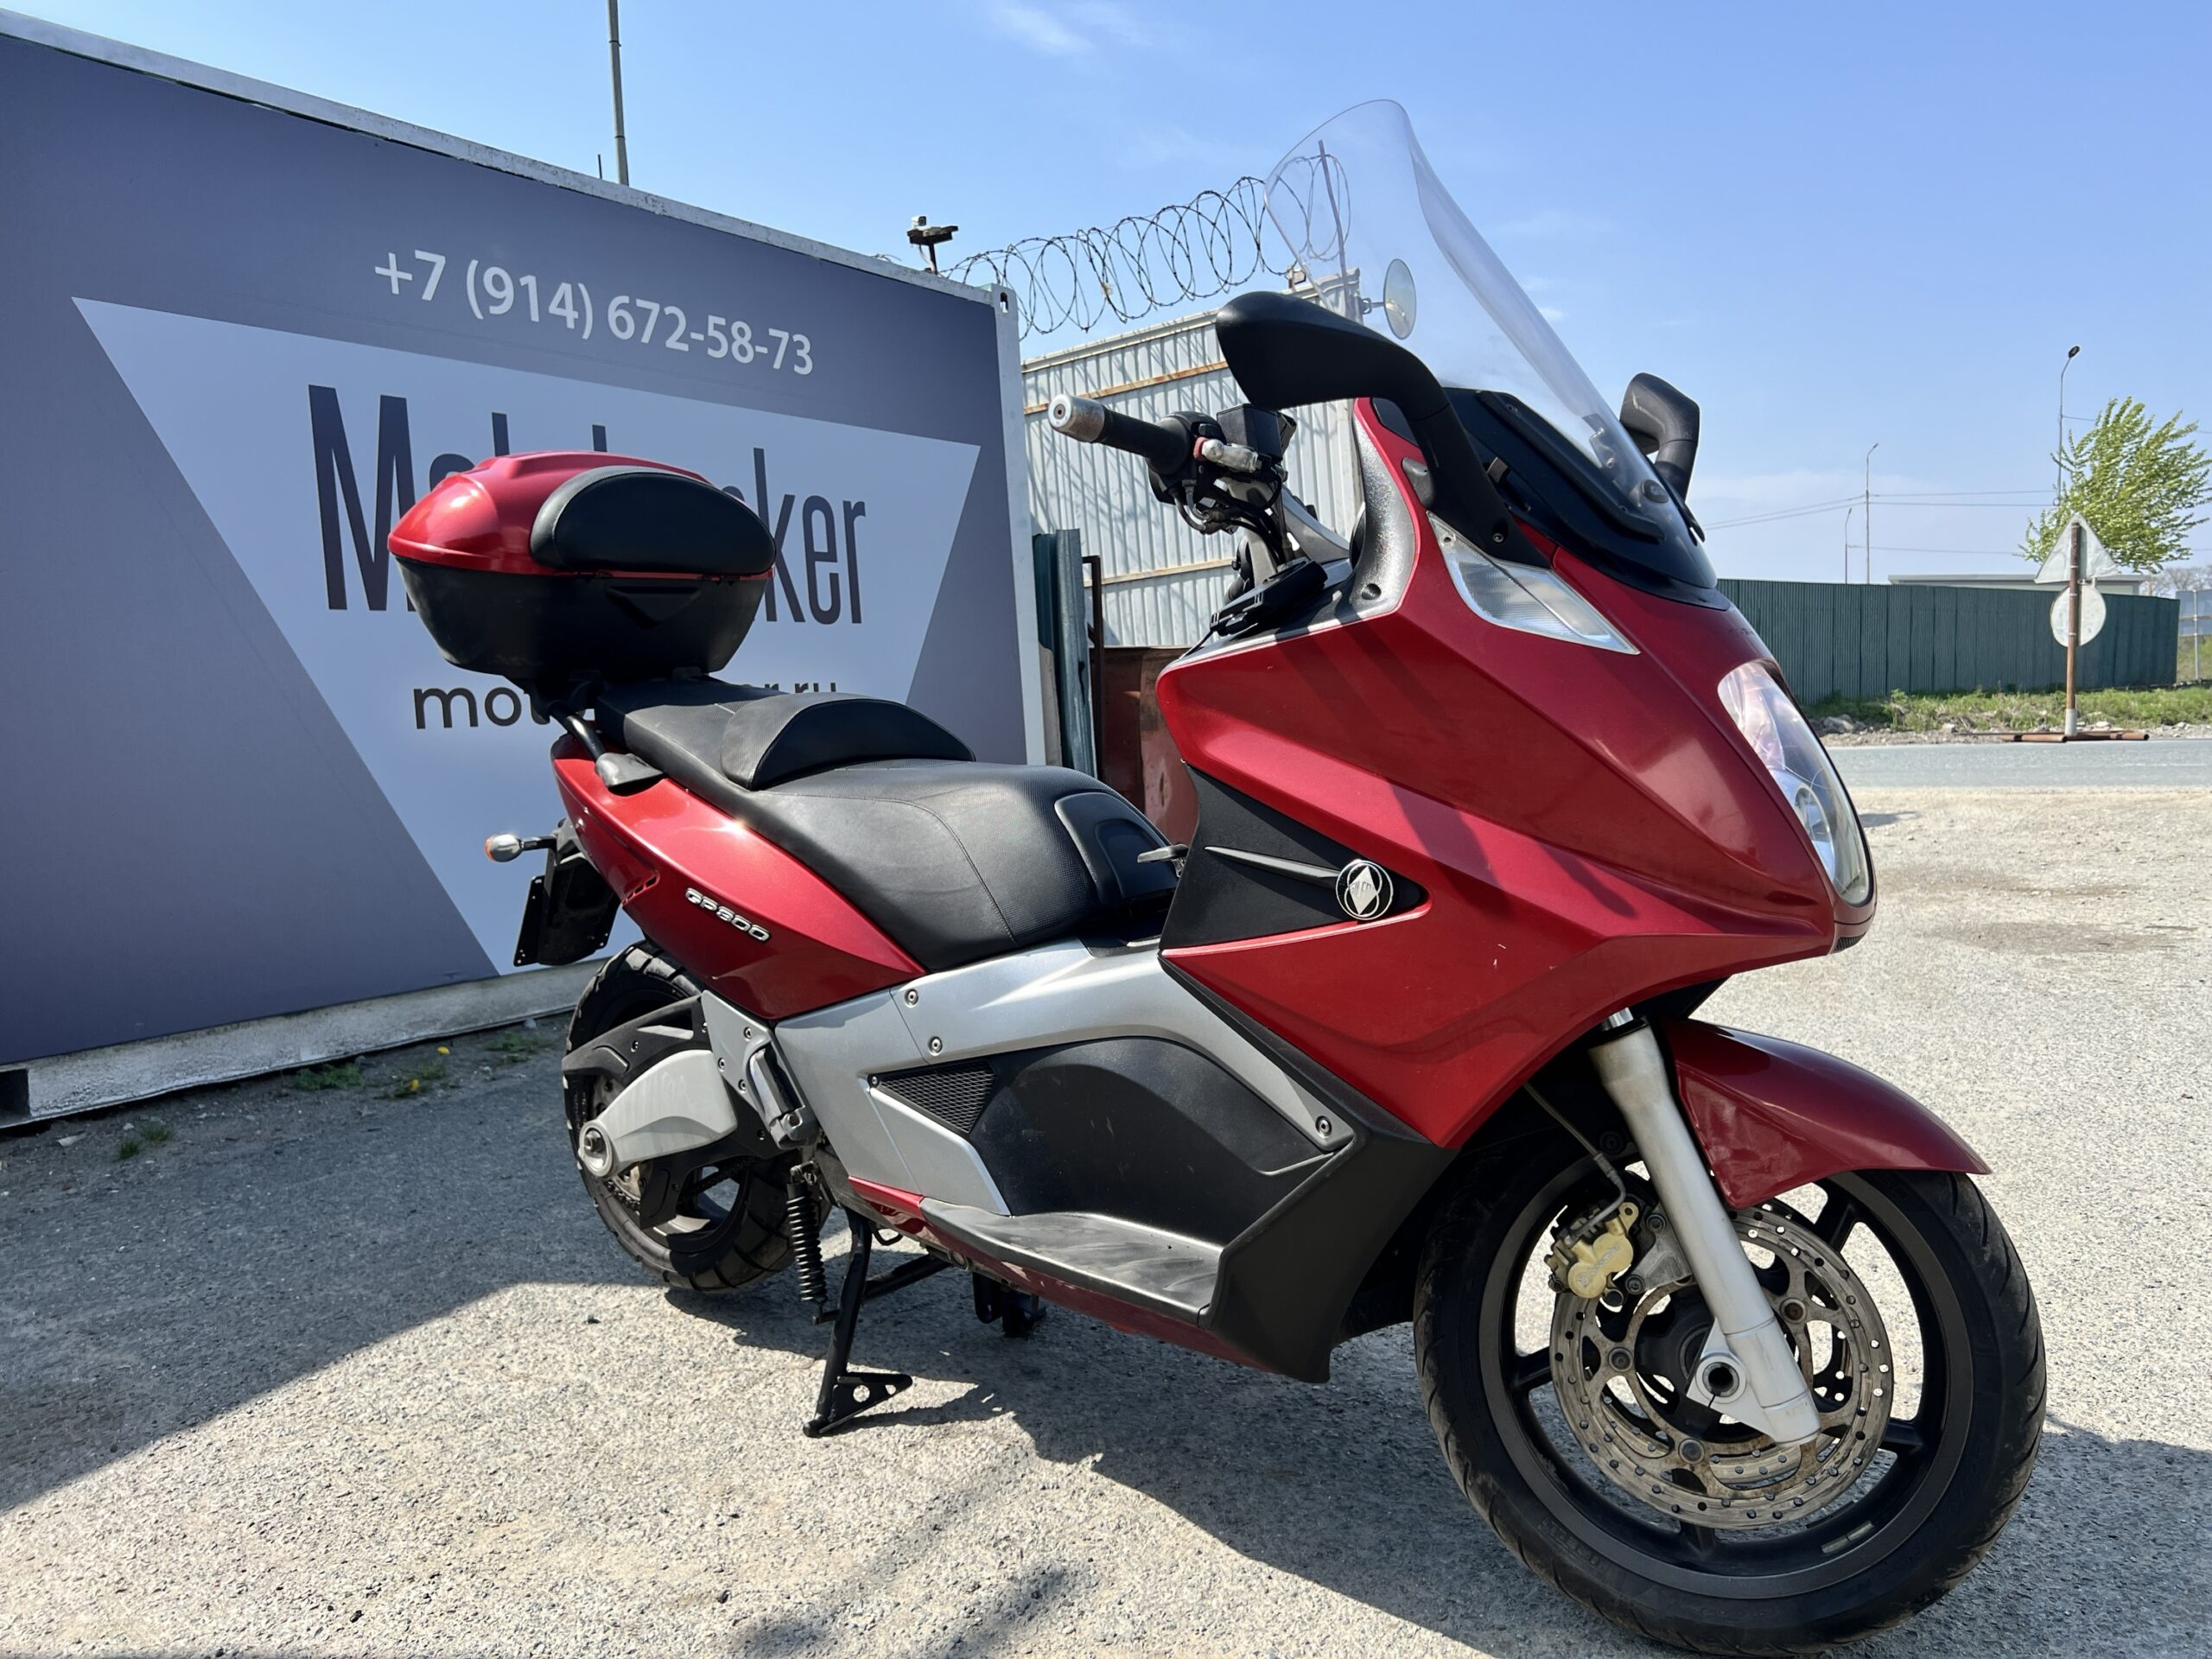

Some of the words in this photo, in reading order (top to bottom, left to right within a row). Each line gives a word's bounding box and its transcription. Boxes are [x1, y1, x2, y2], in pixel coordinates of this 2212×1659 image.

[374, 249, 446, 301] +7
[466, 259, 594, 340] (914)
[607, 295, 814, 375] 672-58-73
[685, 887, 770, 941] GP800
